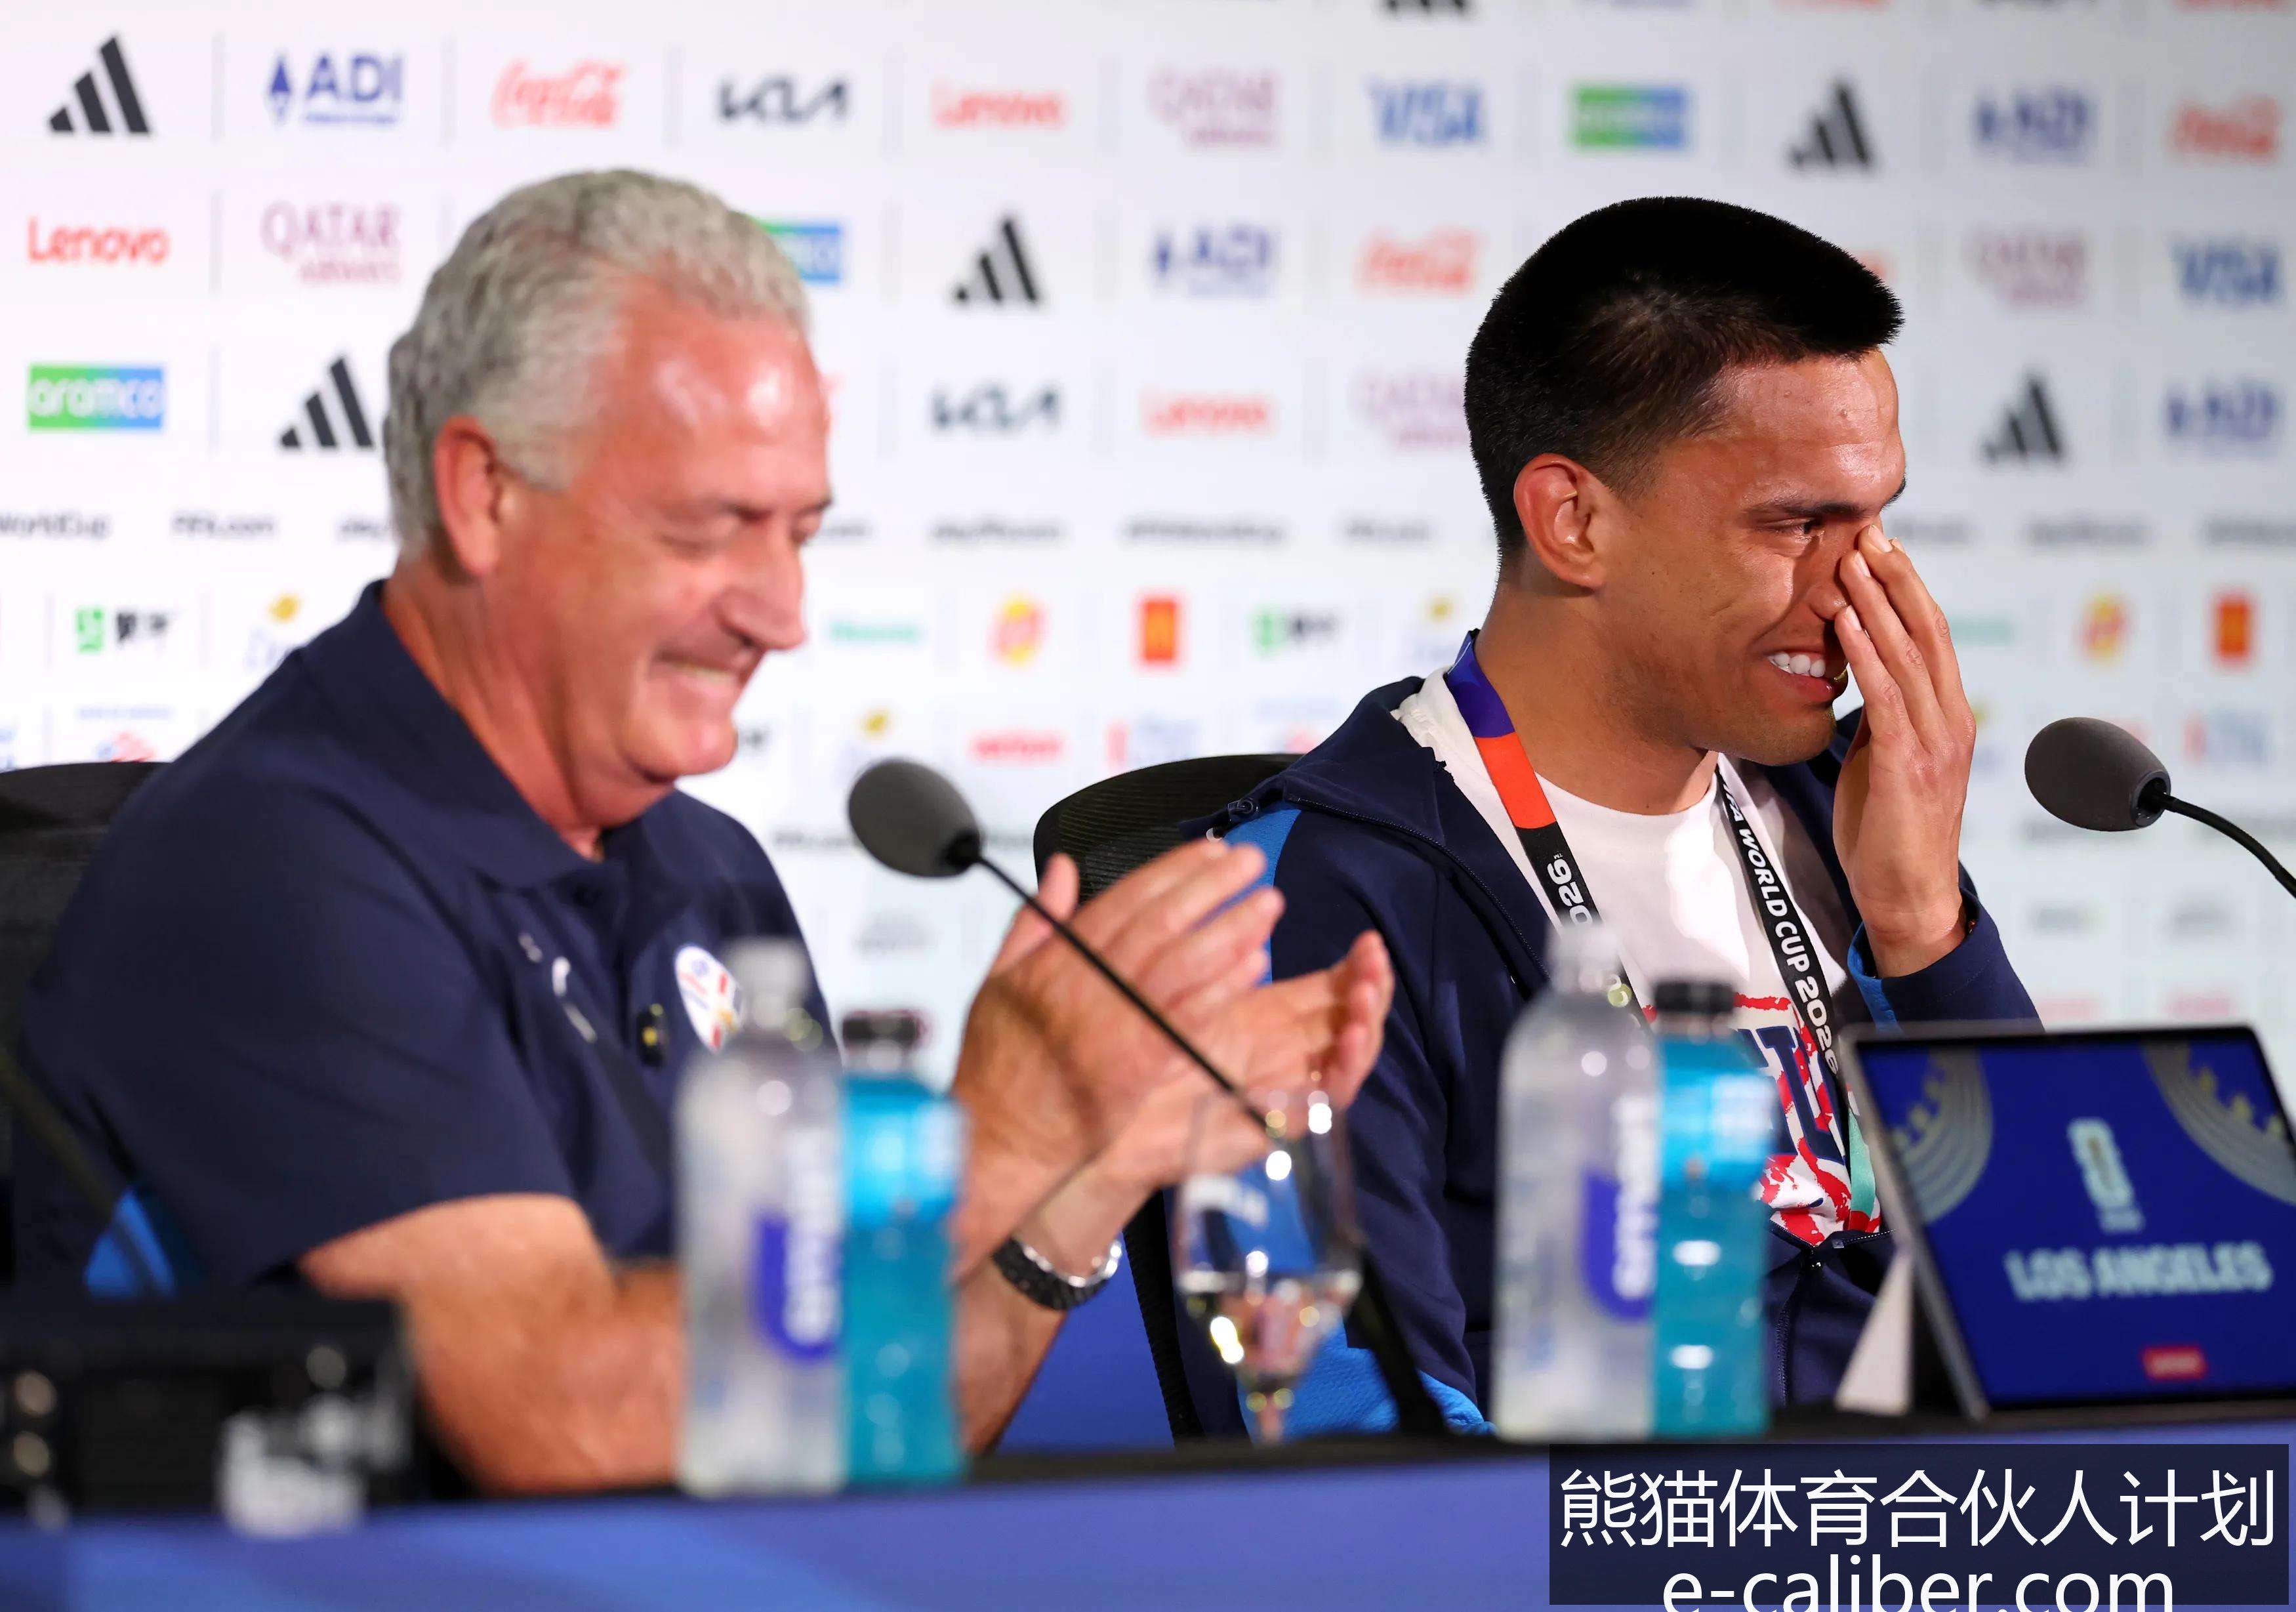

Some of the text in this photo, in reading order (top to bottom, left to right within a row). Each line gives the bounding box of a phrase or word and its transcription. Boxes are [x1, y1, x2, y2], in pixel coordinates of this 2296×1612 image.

[306, 52, 403, 101] ADI
[1368, 76, 1484, 146] VISA
[28, 218, 169, 266] Lenovo
[261, 201, 400, 259] QATAR
[30, 379, 164, 420] aramco
[1739, 828, 1788, 917] WORLD
[1774, 921, 1811, 980] CUP
[1795, 976, 1838, 1075] 2026
[2004, 1241, 2274, 1302] LOS ANGELES
